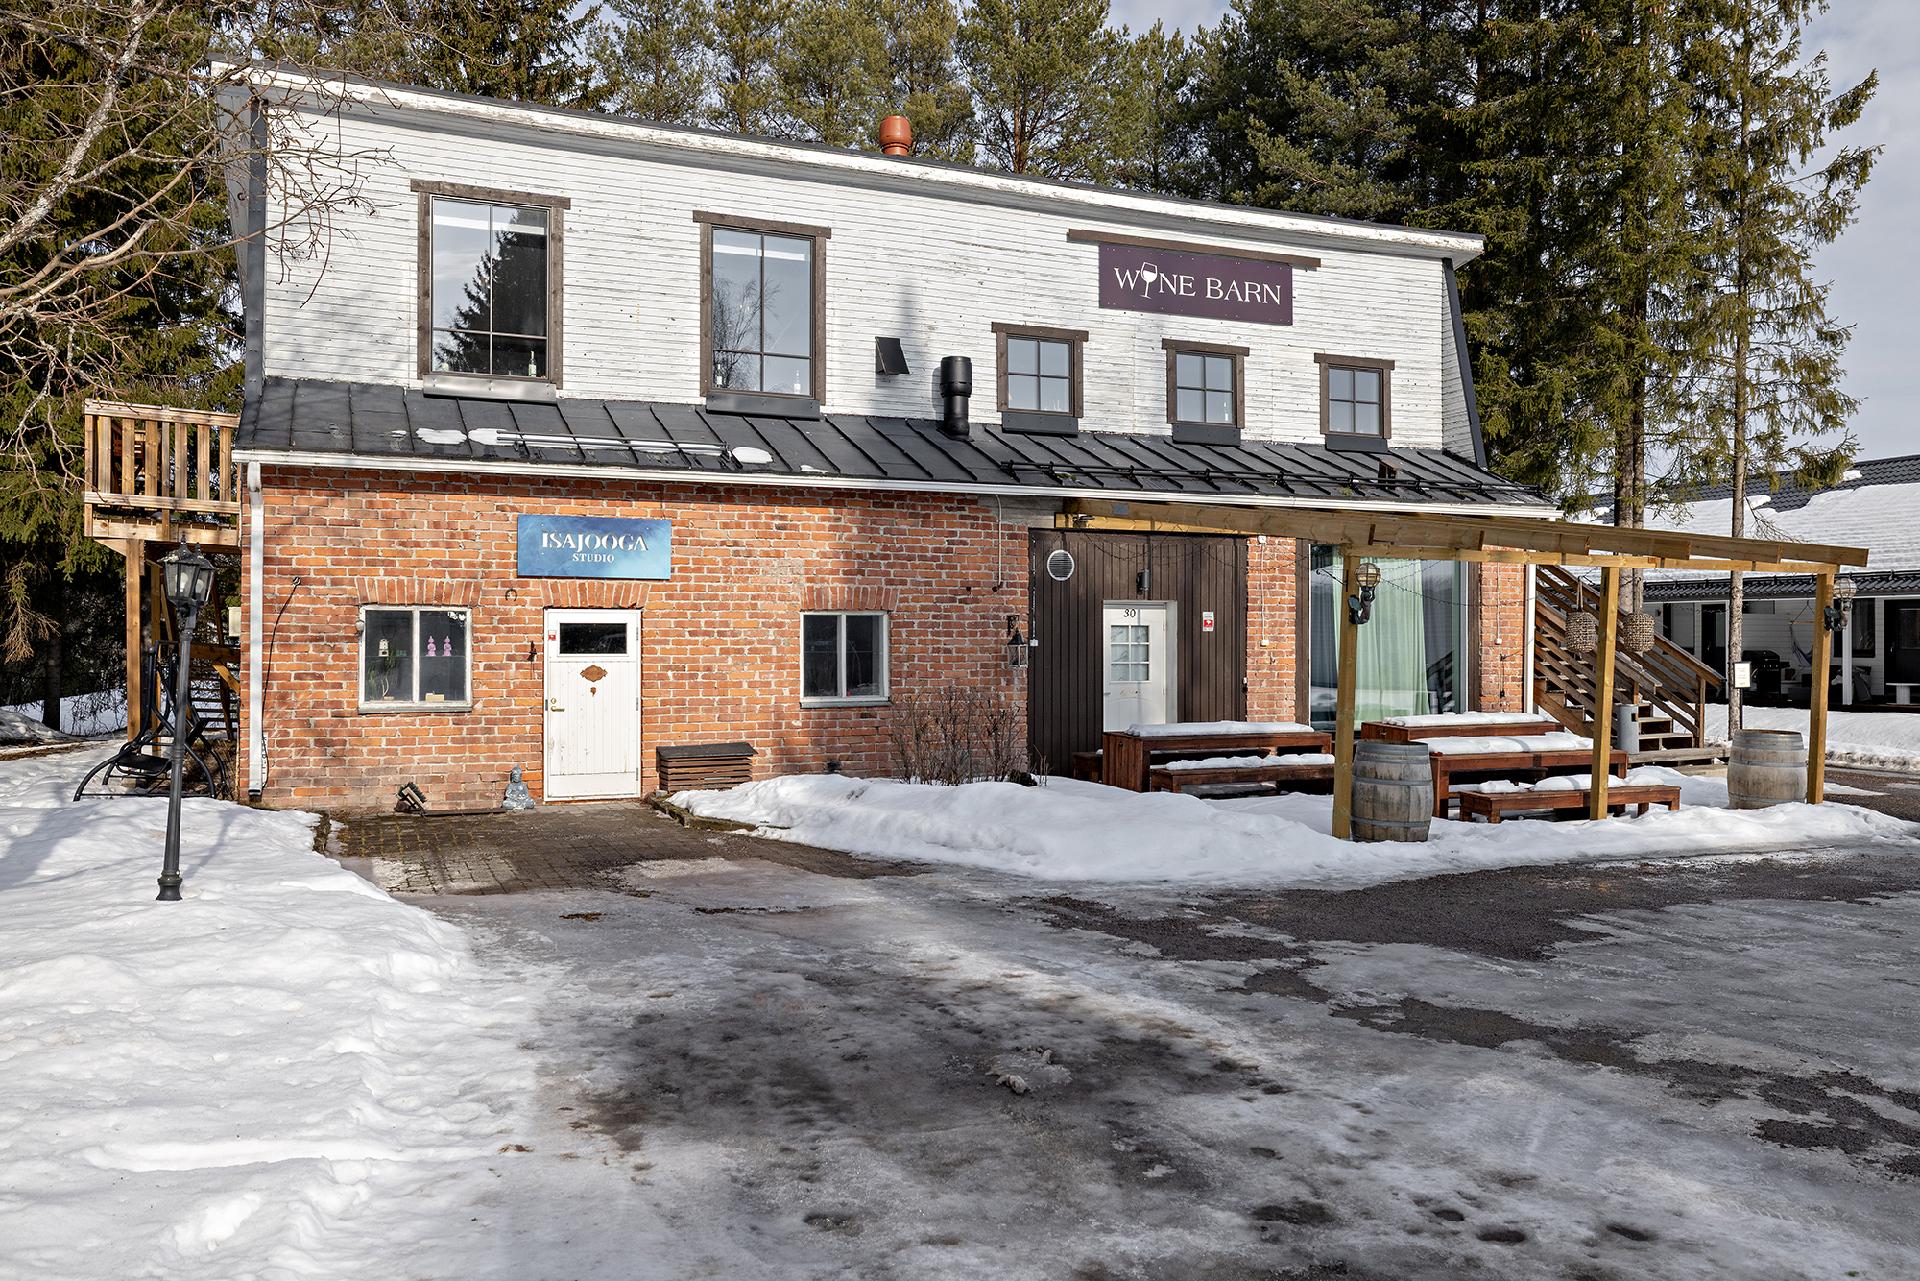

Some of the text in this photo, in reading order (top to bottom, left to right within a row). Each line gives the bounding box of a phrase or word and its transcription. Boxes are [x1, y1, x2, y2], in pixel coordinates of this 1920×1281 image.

[1205, 277, 1281, 305] BARN
[541, 532, 649, 553] ISAJOOGA
[572, 552, 615, 563] STUDIO
[1123, 608, 1137, 618] 30
